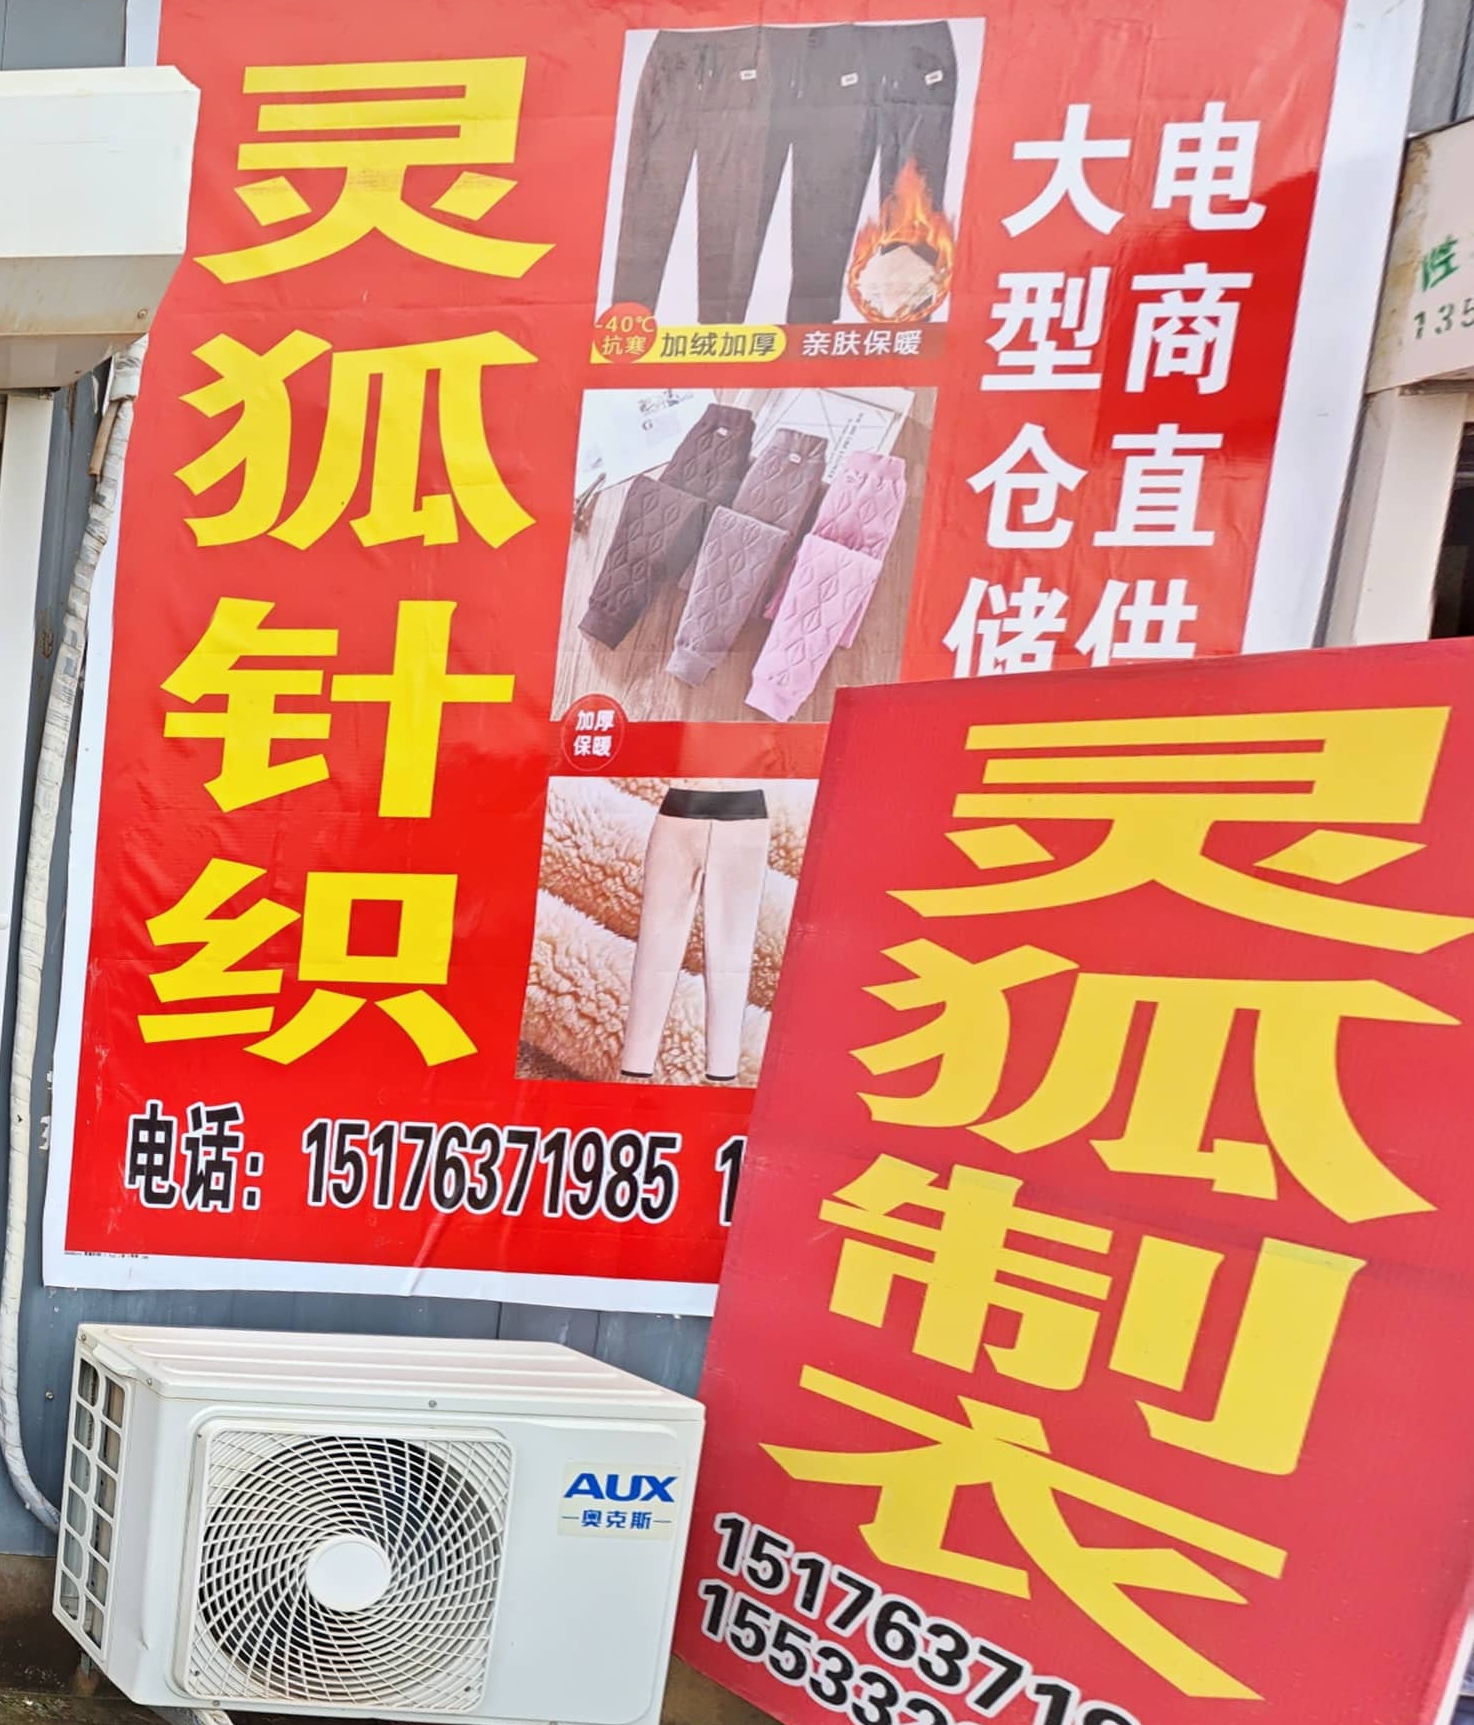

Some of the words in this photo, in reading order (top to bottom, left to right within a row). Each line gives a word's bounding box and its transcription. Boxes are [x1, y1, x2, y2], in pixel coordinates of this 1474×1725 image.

[601, 335, 647, 356] 抗寒
[659, 331, 778, 358] 加绒加厚
[802, 329, 922, 357] 亲肤保暖
[943, 103, 1130, 679] 大型仓储
[1075, 101, 1267, 666] 电商直供
[138, 55, 554, 1069] 灵狐针织
[574, 708, 615, 733] 加厚
[572, 735, 612, 758] 保暖
[302, 1117, 682, 1224] 15176371985
[758, 705, 1473, 1701] 灵狐制衣
[563, 1472, 678, 1503] AUX
[581, 1509, 653, 1530] 奥克斯
